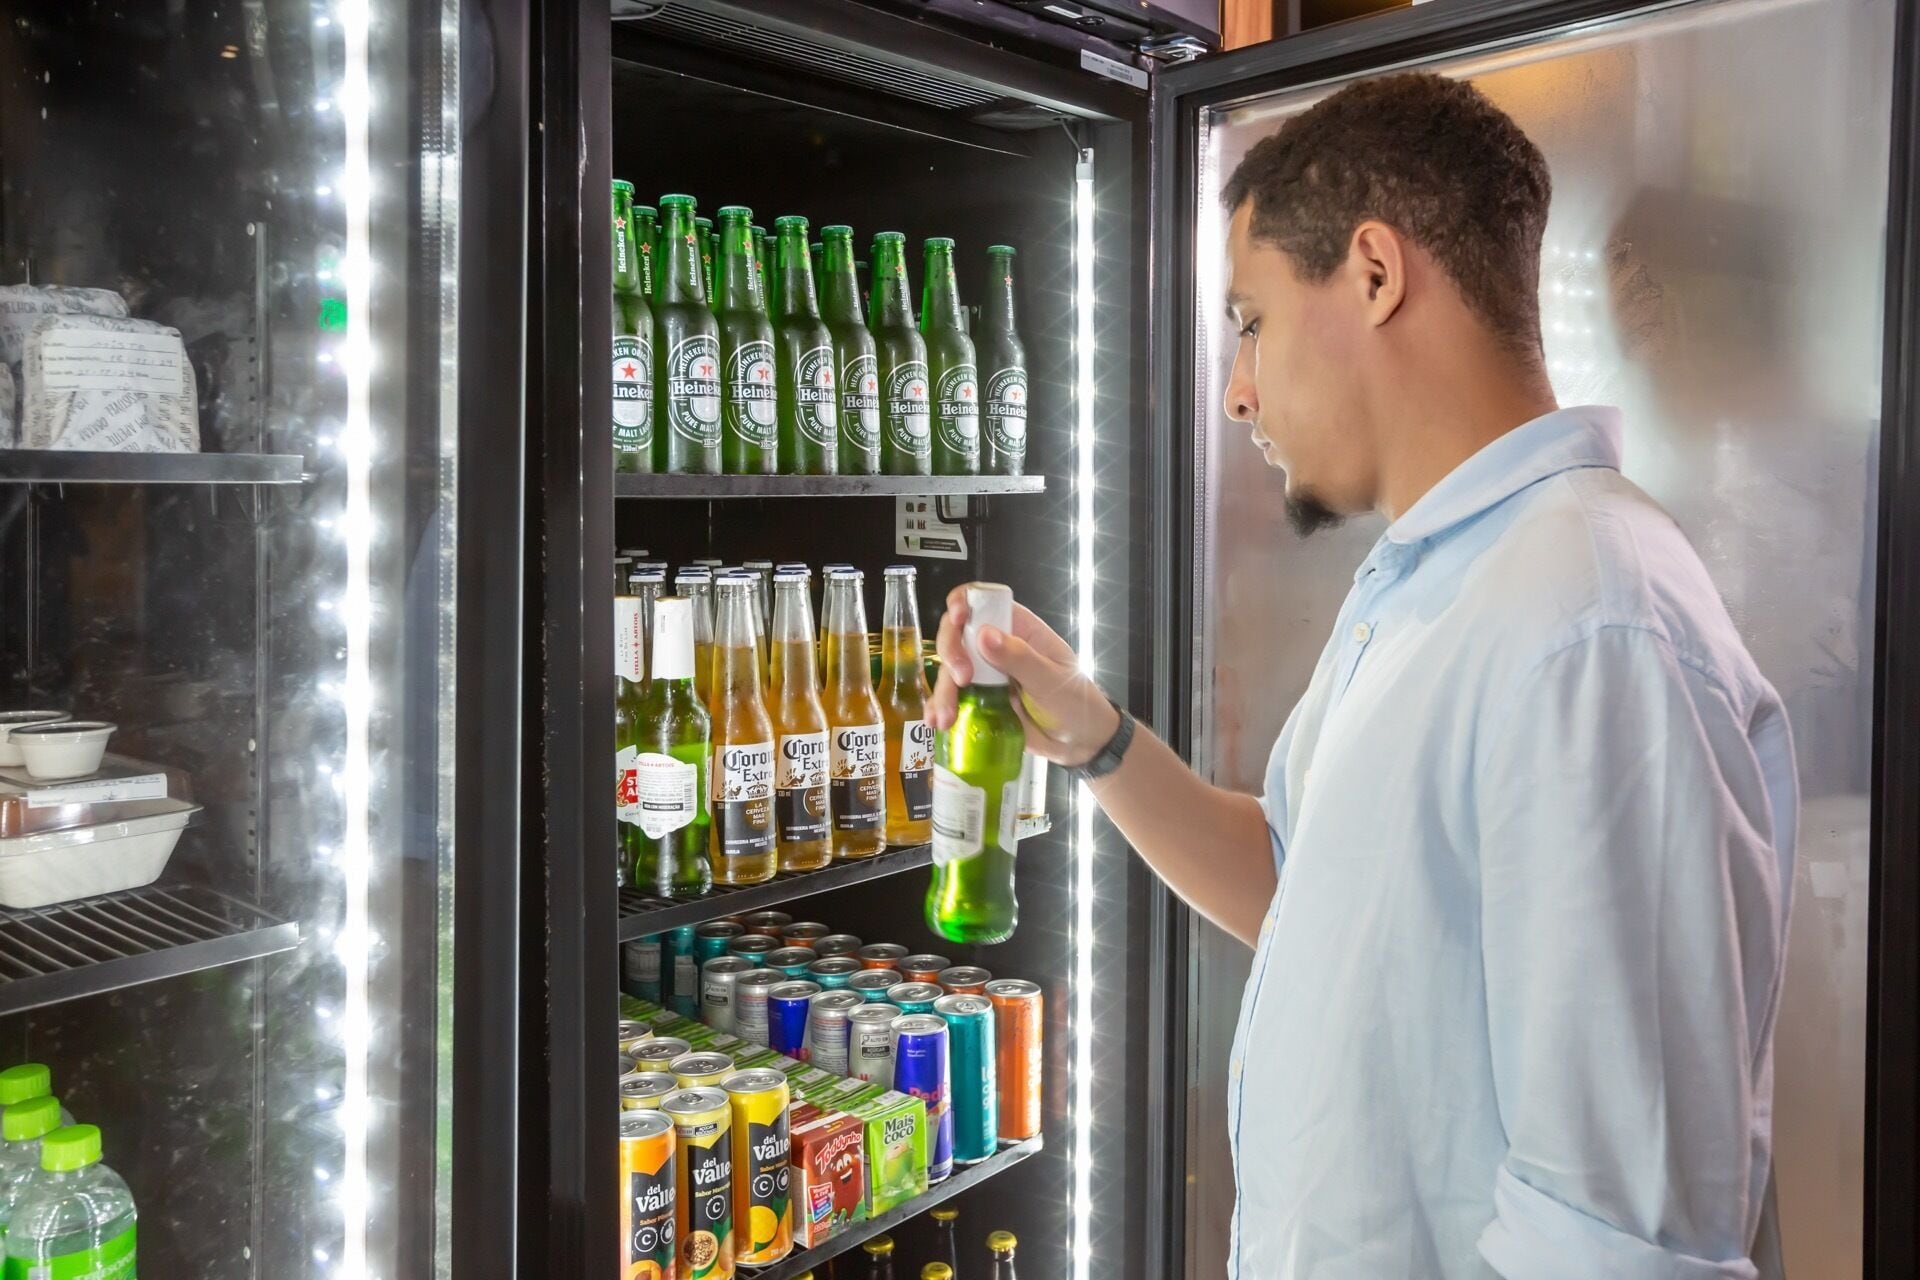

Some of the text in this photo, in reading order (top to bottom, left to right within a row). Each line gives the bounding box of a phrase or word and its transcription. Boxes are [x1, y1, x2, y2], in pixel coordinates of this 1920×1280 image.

[617, 231, 626, 273] Heineken
[642, 255, 652, 294] Heineken
[688, 246, 697, 286] Heineken
[681, 411, 698, 429] PURE
[740, 414, 755, 431] PURE
[618, 428, 638, 438] MALT
[783, 738, 826, 763] Coro
[838, 731, 882, 754] Coro
[722, 749, 773, 774] Coron
[855, 748, 880, 762] Extr
[884, 1113, 915, 1137] Mais
[884, 1124, 915, 1145] coco
[752, 1137, 789, 1161] Valle
[763, 1133, 776, 1145] del
[703, 1157, 717, 1168] del
[815, 1131, 861, 1176] Toddynho
[692, 1160, 731, 1185] Valle
[635, 1187, 676, 1213] Valle
[647, 1183, 660, 1195] del
